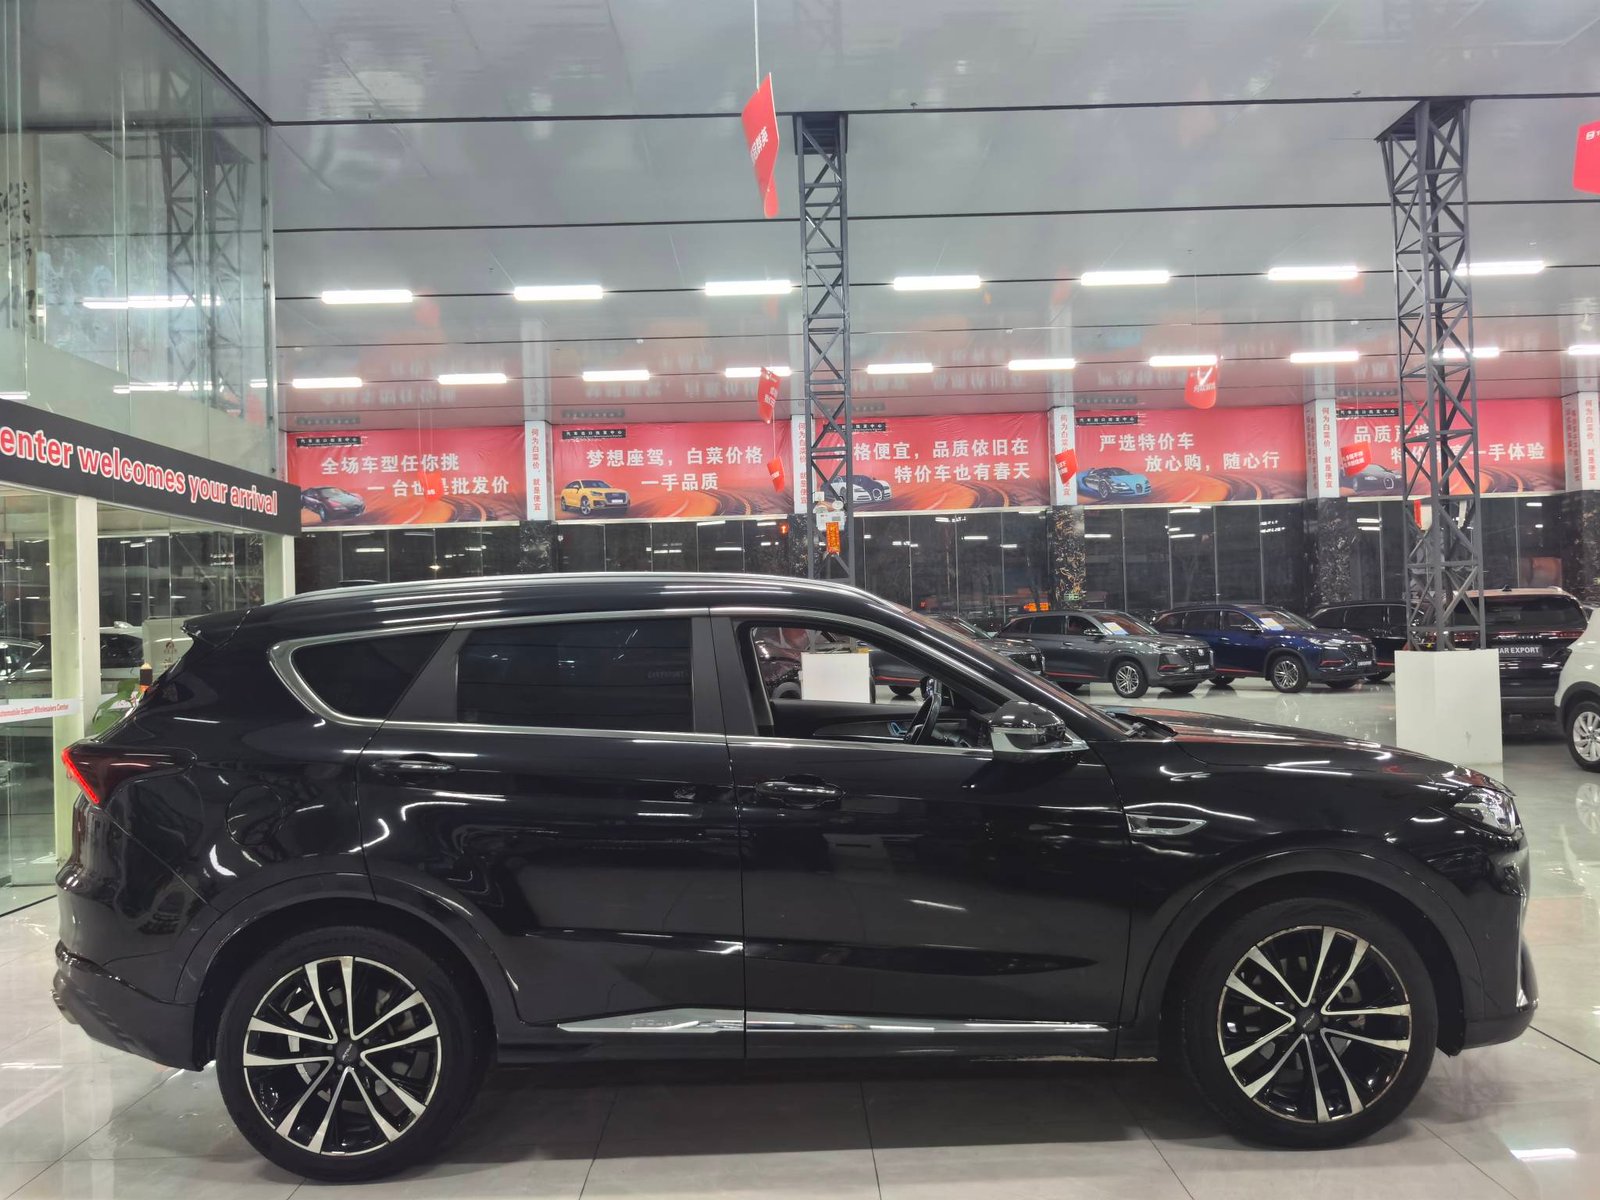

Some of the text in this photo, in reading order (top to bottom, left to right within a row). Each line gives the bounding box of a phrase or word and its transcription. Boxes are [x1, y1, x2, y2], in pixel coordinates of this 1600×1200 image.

[1099, 432, 1194, 452] 严选特价车
[321, 453, 459, 475] 全场车型任你挑
[587, 446, 763, 468] 梦想座驾，白菜价格
[1145, 451, 1280, 473] 放心购，随心行
[77, 447, 185, 494] welcomes
[188, 474, 228, 503] your
[230, 485, 278, 516] arrival
[641, 472, 719, 491] 一手品质
[895, 462, 1030, 484] 特价车也有春天
[1510, 646, 1540, 654] EXPORT
